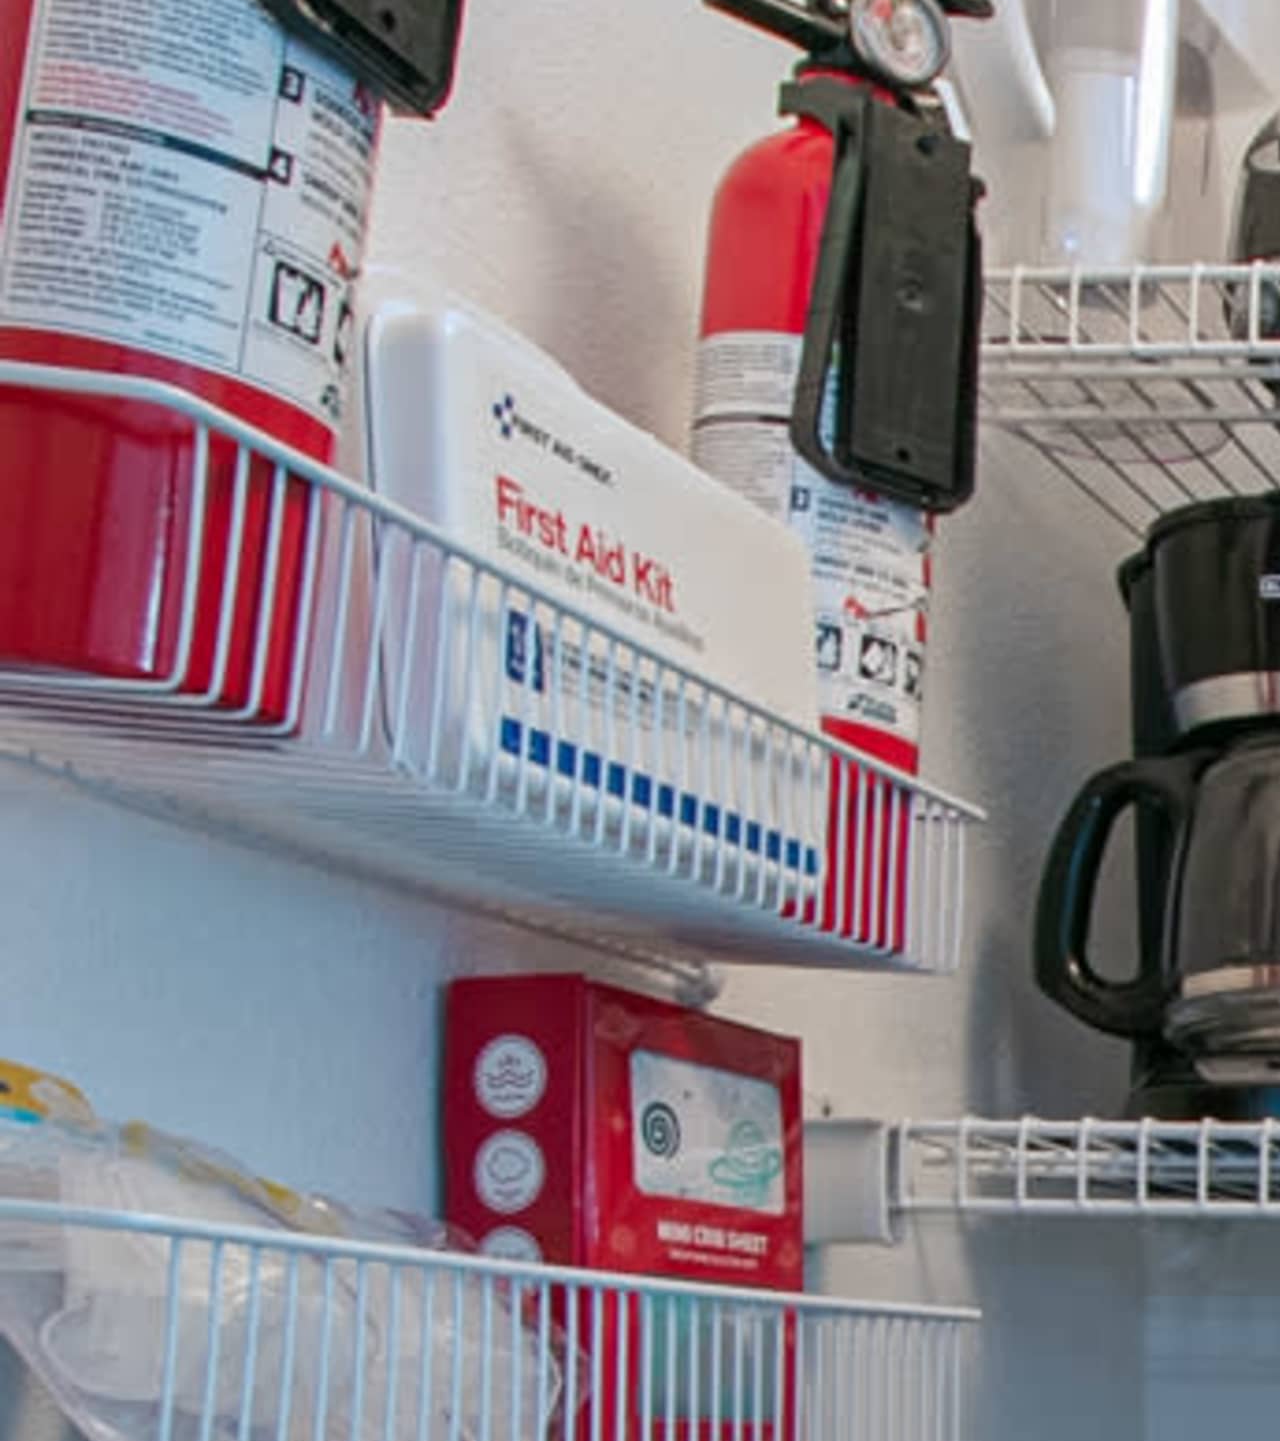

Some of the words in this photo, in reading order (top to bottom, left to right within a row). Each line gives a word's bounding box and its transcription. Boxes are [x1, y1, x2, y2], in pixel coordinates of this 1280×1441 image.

[497, 475, 568, 555] First
[575, 522, 625, 586] Aid
[633, 551, 675, 612] Kit
